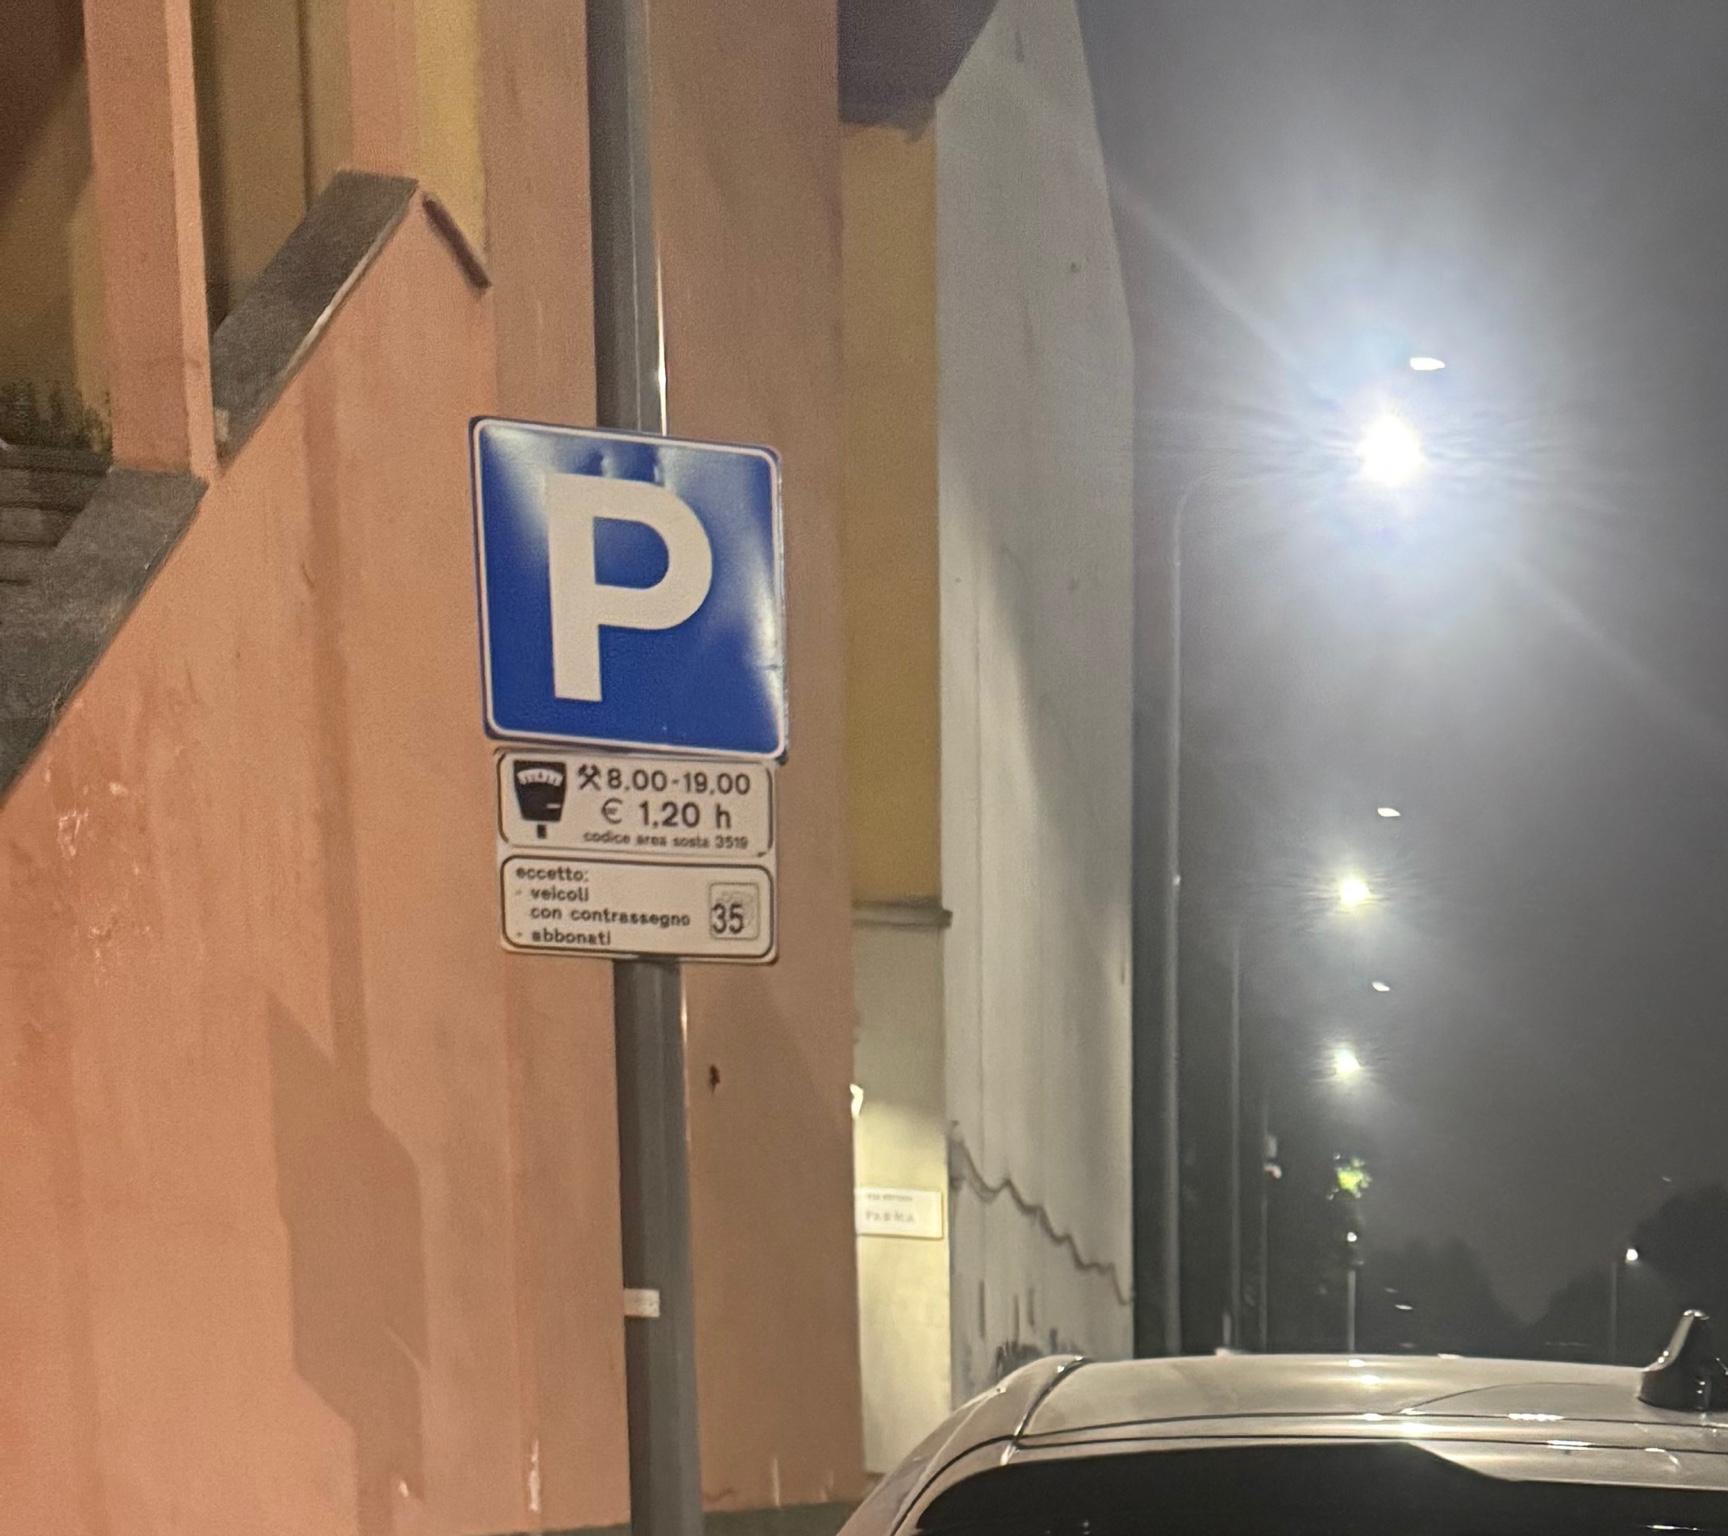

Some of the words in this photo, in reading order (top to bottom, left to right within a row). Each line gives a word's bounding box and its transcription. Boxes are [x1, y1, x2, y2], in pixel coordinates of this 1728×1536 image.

[547, 472, 713, 702] P
[601, 798, 623, 825] €
[715, 804, 732, 829] h
[583, 831, 631, 845] codice
[636, 834, 667, 847] area
[672, 834, 710, 848] sosta
[515, 866, 589, 882] eccetto:
[530, 886, 589, 901] veicoli
[530, 906, 562, 921] con
[570, 909, 691, 929] contrassegno
[711, 902, 744, 934] 35
[531, 931, 612, 946] abbonati
